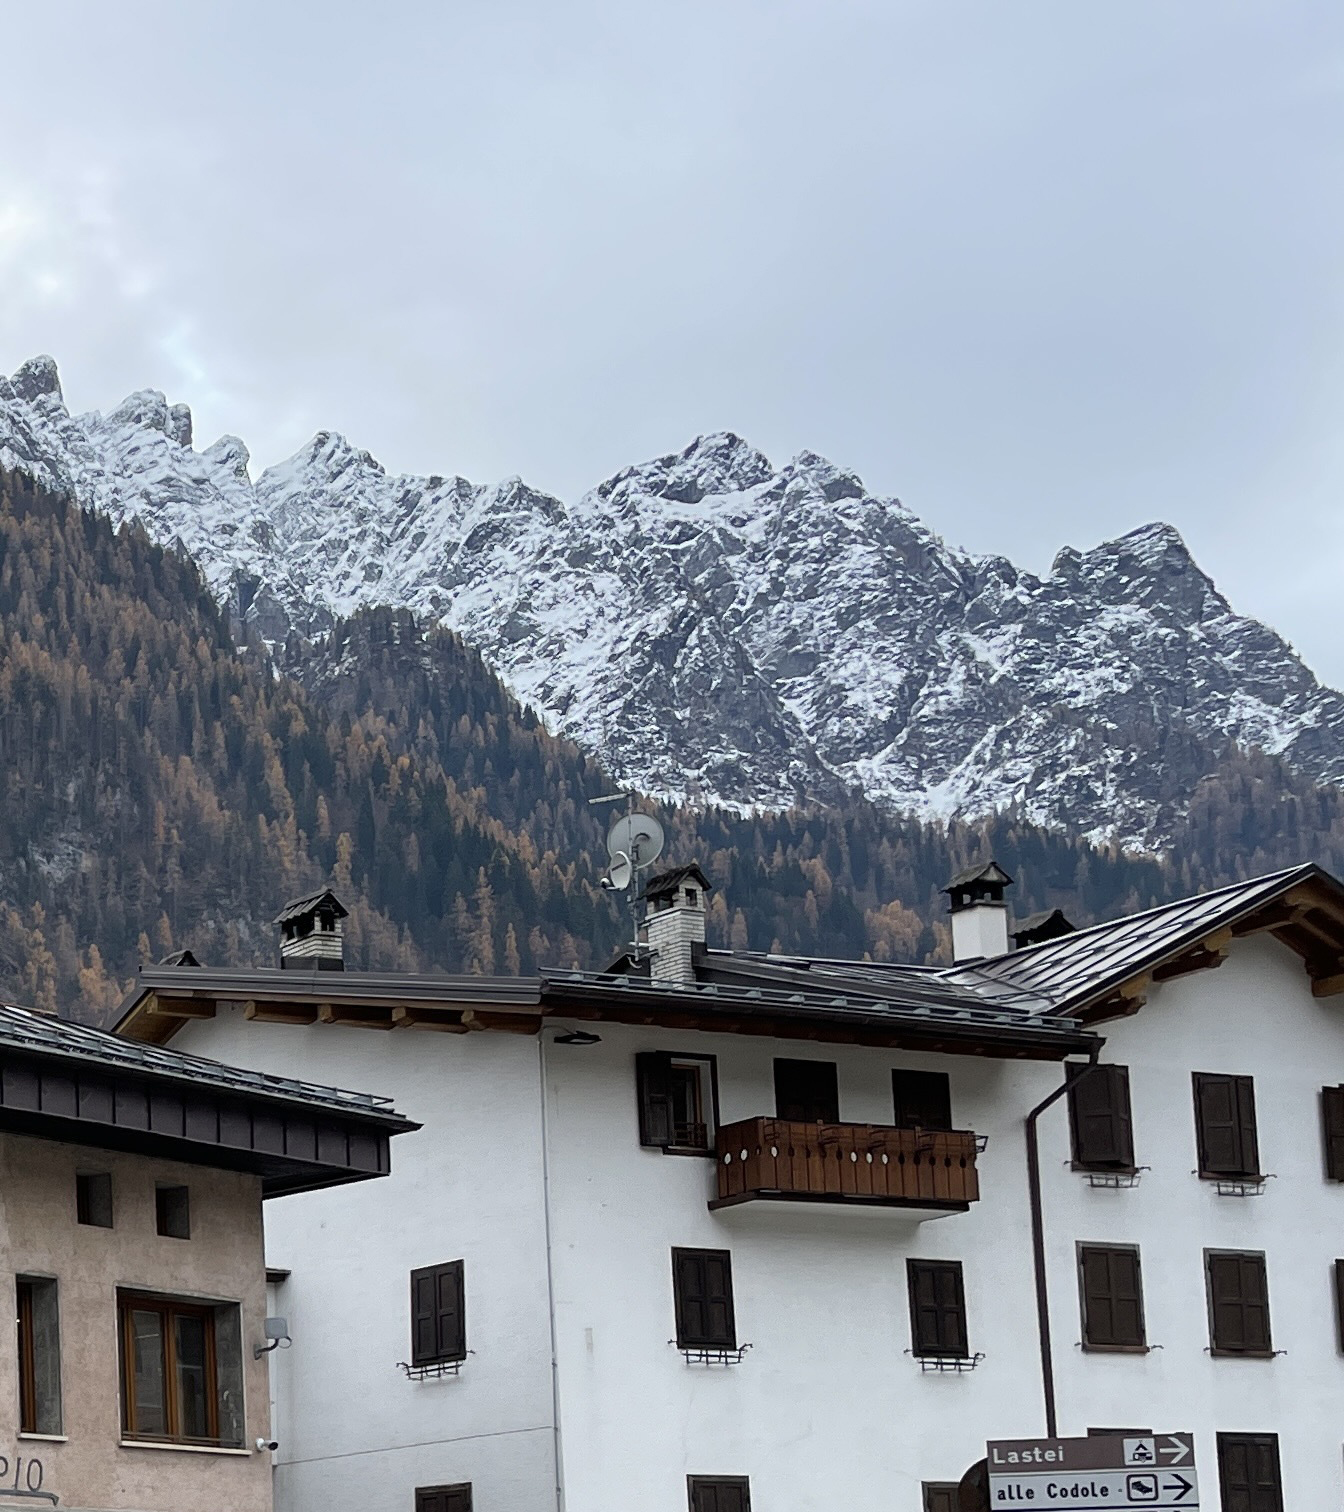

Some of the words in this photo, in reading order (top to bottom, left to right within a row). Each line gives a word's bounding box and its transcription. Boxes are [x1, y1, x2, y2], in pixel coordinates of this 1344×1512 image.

[993, 1446, 1064, 1464] Lastei
[997, 1484, 1035, 1500] alle
[1047, 1481, 1109, 1499] Codole
